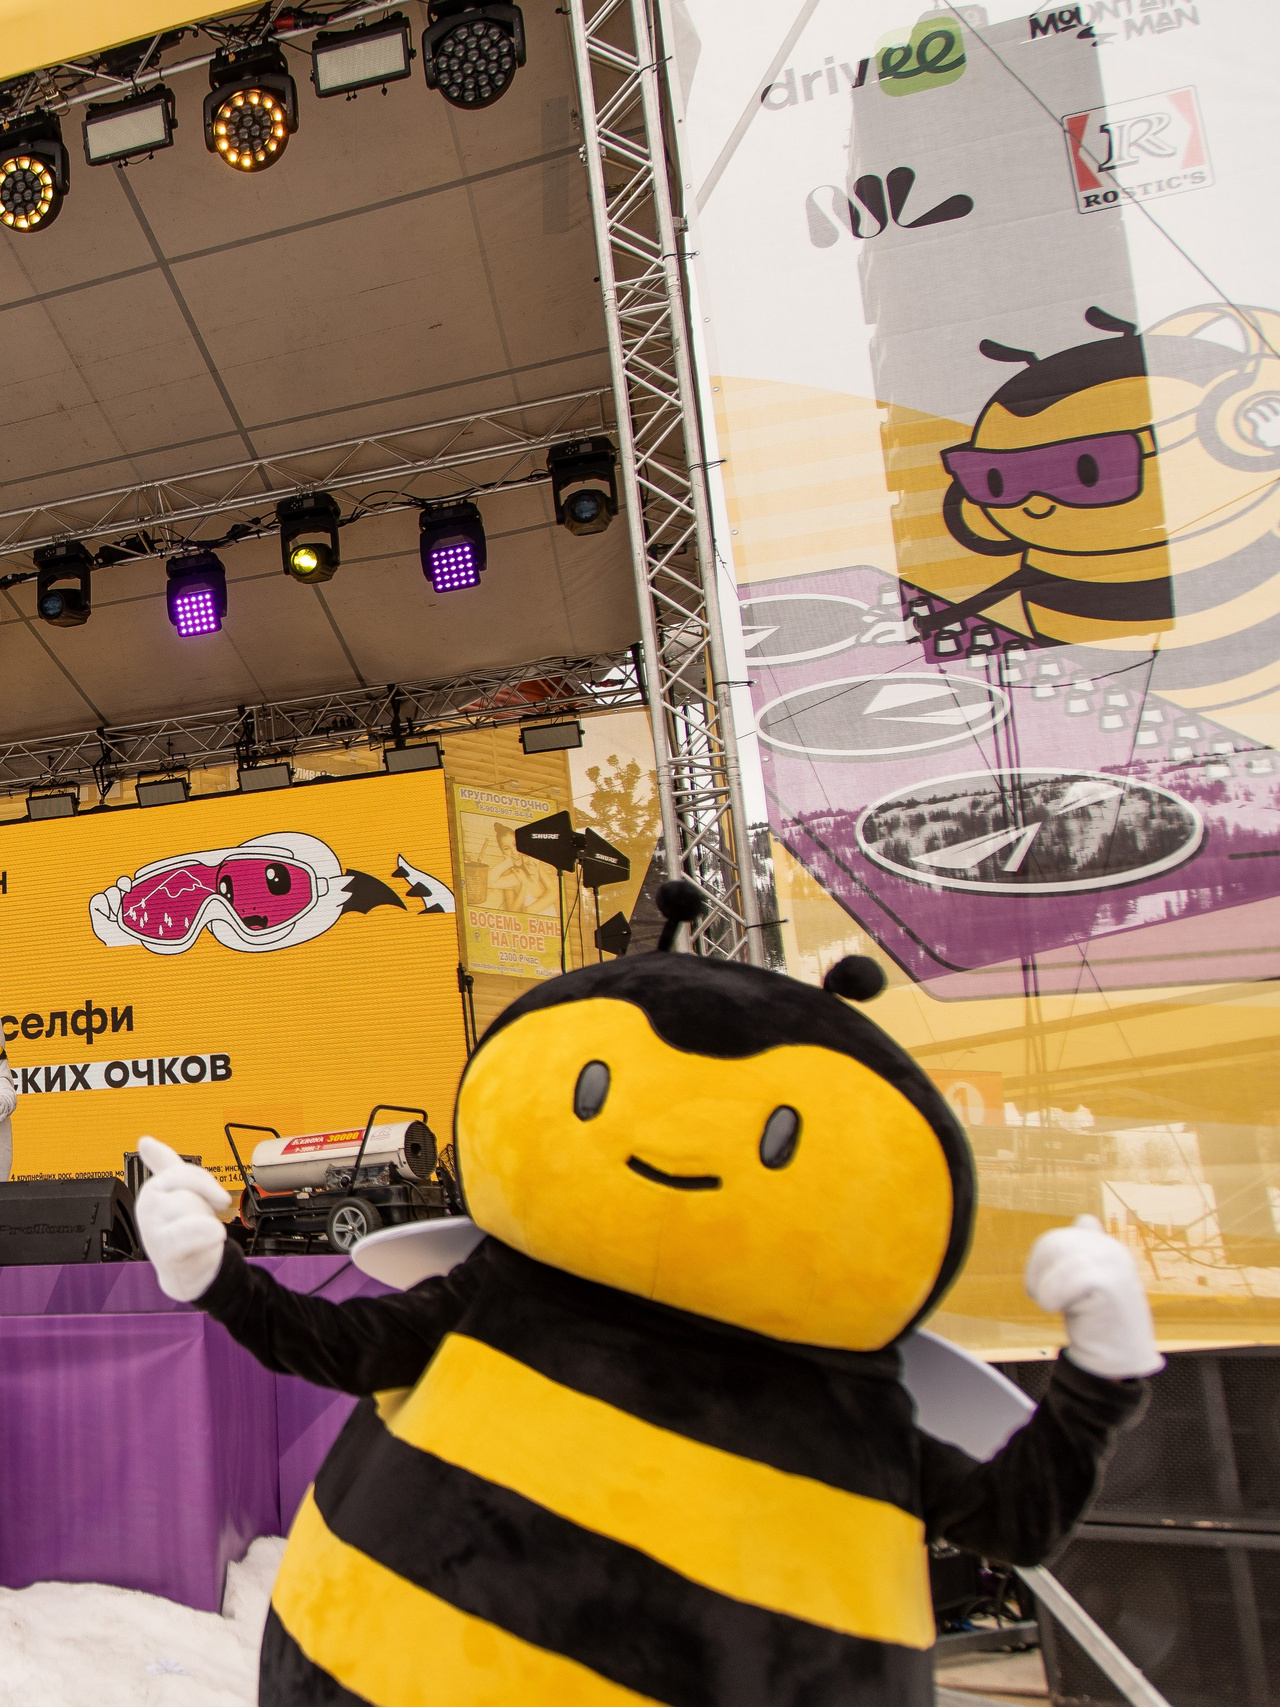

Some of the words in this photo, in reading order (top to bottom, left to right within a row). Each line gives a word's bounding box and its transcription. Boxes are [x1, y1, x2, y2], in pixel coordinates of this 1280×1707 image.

[761, 30, 967, 111] drivee
[1083, 171, 1206, 208] ROSTIC'S
[460, 788, 550, 812] КРУГЛОСУТОЧНО
[595, 853, 619, 864] SHURE
[470, 911, 522, 932] ВОСЕМЬ
[491, 931, 509, 948] НА
[512, 934, 545, 952] ГОРЕ
[500, 951, 517, 962] 2300
[1, 1000, 134, 1045] селфи
[104, 1053, 233, 1089] очков
[327, 1132, 360, 1142] 30000
[75, 1170, 113, 1180] операторов
[115, 1169, 125, 1177] мо
[229, 1173, 244, 1182] 14.0
